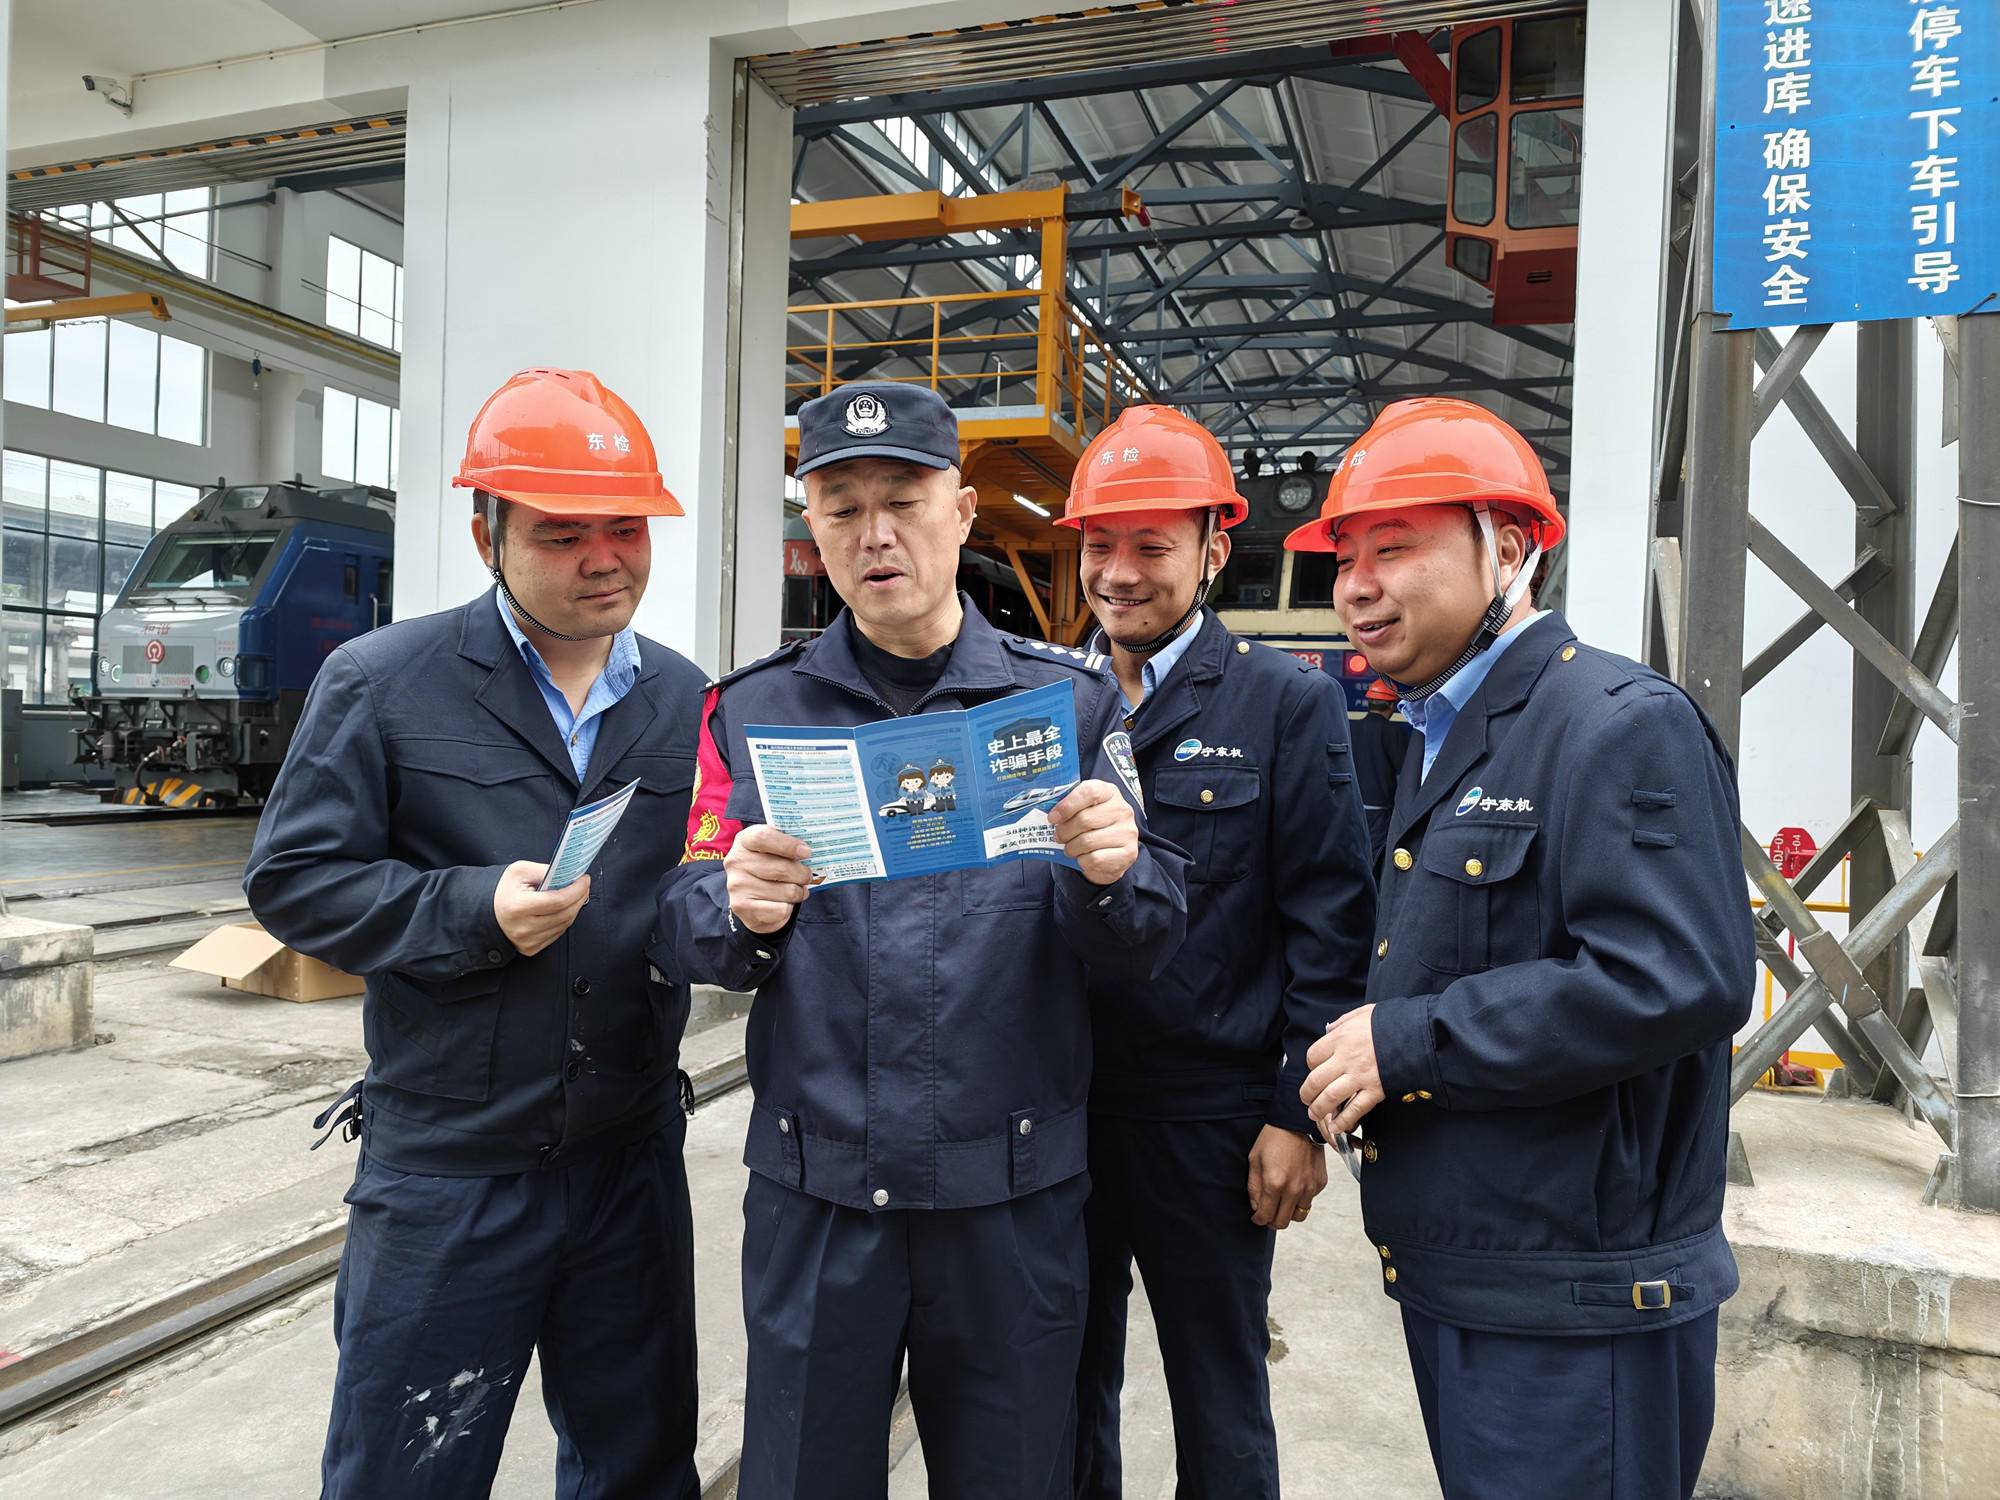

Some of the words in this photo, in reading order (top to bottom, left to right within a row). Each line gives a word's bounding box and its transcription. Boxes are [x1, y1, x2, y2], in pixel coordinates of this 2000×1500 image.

[1907, 0, 1962, 97] 停车
[1907, 107, 1962, 294] 下车引导
[1762, 127, 1811, 307] 确保安全
[585, 432, 631, 452] 东检
[1100, 447, 1140, 466] 东检
[987, 724, 1061, 757] 史上最全
[989, 743, 1064, 774] 诈骗手段
[1479, 796, 1534, 813] 宁东机
